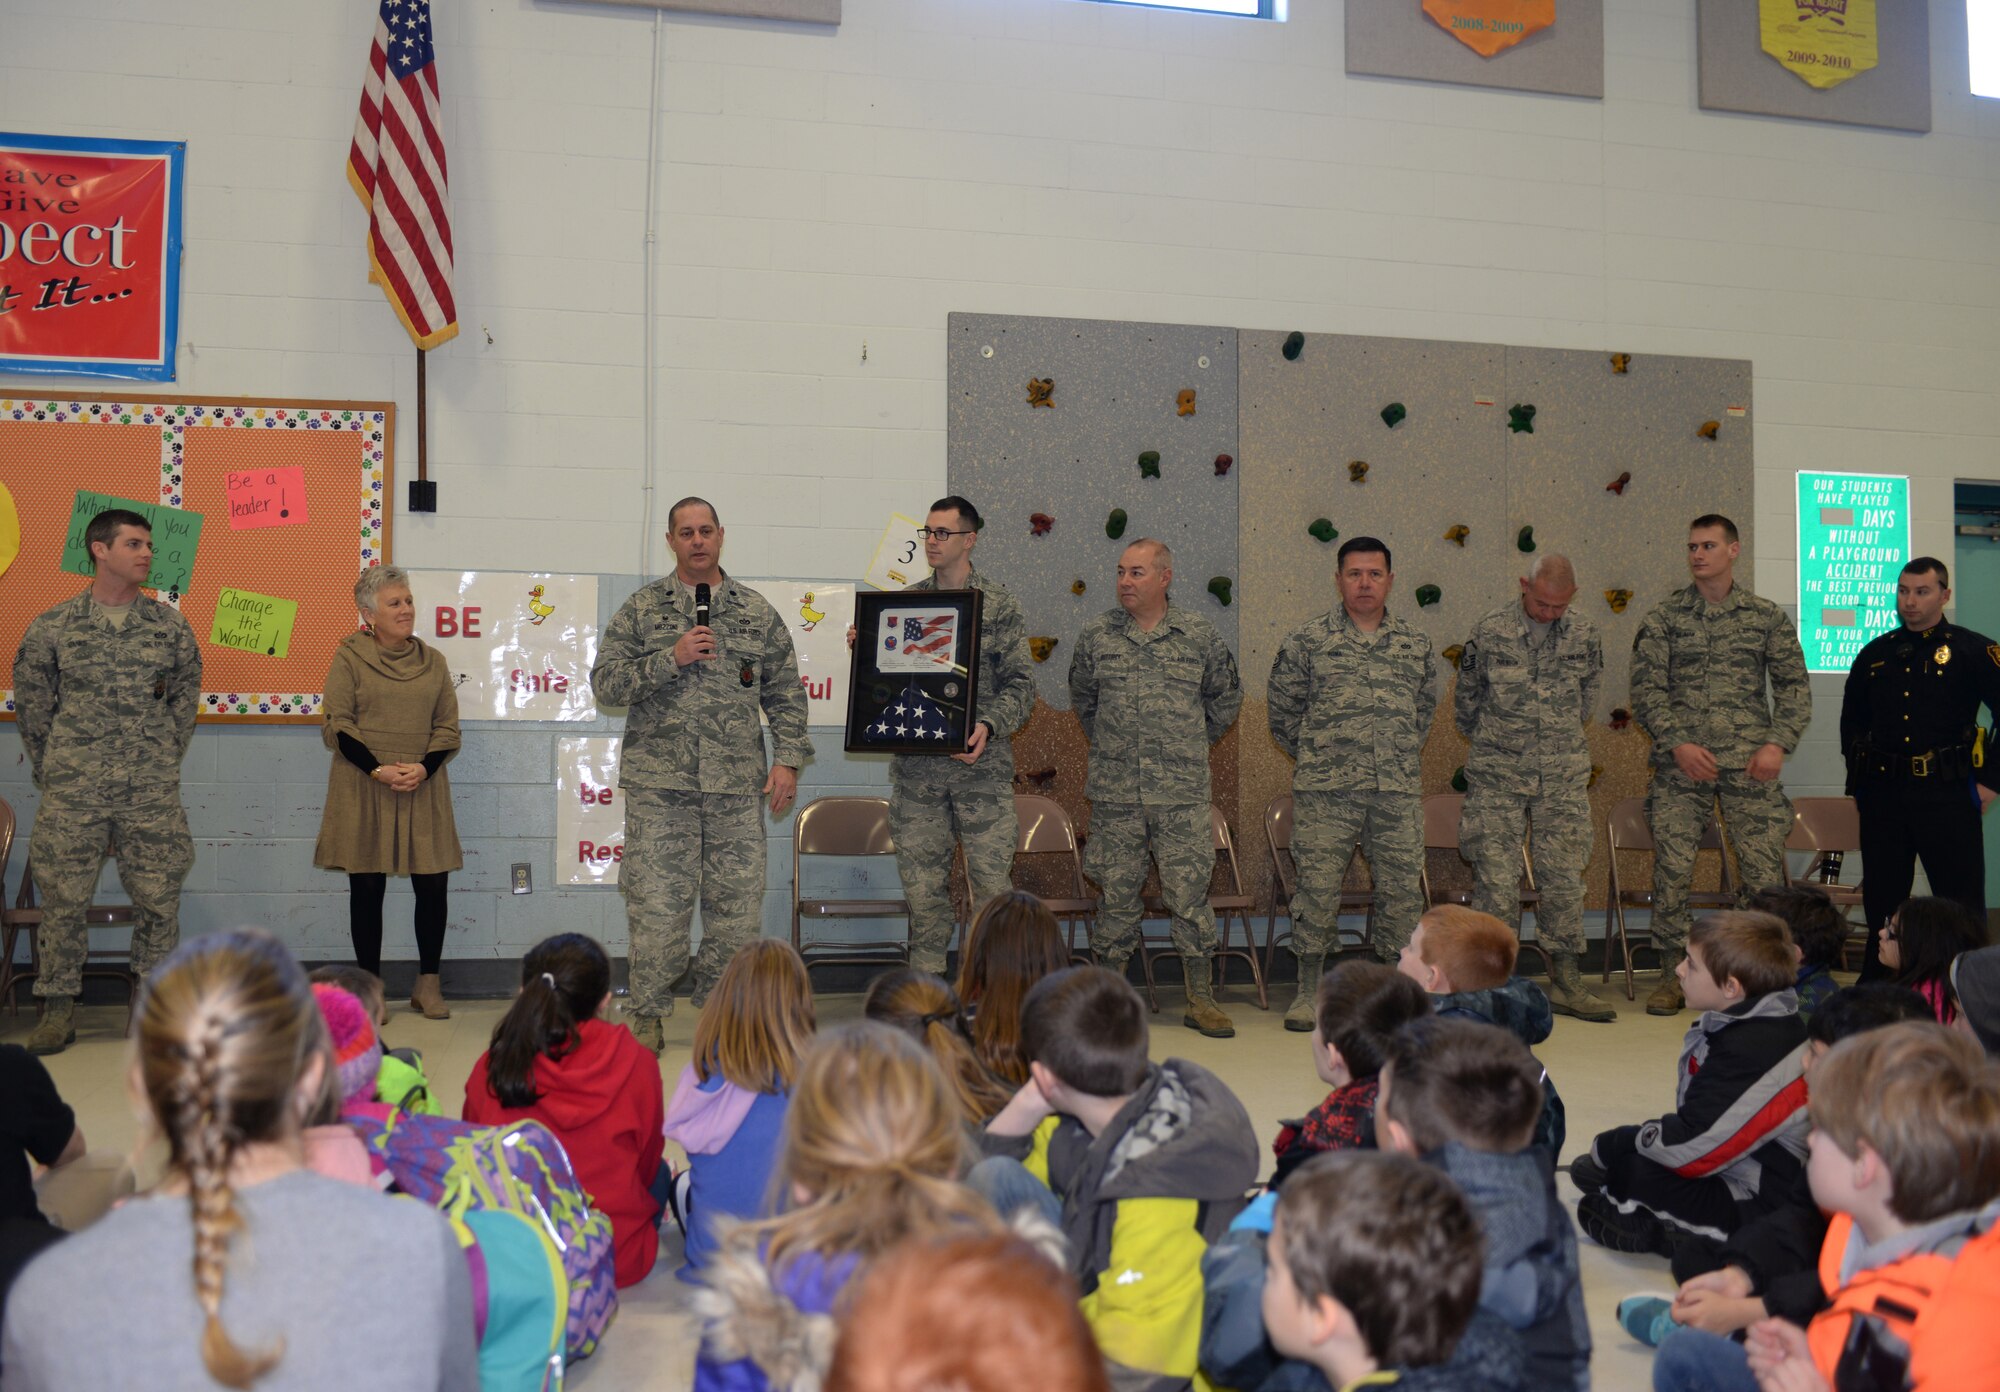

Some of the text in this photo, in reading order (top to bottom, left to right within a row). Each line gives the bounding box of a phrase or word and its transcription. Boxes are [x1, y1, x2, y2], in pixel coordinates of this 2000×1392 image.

[1451, 15, 1524, 33] 2008-2009
[1787, 49, 1851, 68] 2009-2010
[0, 169, 79, 188] ave
[227, 473, 276, 490] Be a
[1814, 479, 1892, 493] OUR STUDENTS
[231, 495, 271, 517] leader
[1817, 493, 1889, 506] HAVE PLAYED
[1862, 509, 1895, 528] DAYS
[1829, 529, 1880, 544] WITHOUT
[897, 540, 917, 564] 3
[1808, 545, 1900, 562] A PLAYGROUND
[1826, 563, 1883, 578] ACCIDENT
[1806, 580, 1823, 592] THE
[1829, 581, 1852, 593] BEST
[219, 590, 274, 619] Change
[1823, 594, 1886, 607] RECORD WAS
[238, 615, 262, 632] the
[436, 606, 481, 638] BE
[1865, 609, 1898, 628] DAYS
[219, 627, 260, 649] World
[1815, 628, 1829, 640] DO
[1837, 629, 1863, 641] YOUR
[1820, 642, 1864, 654] TO KEEP
[1820, 655, 1856, 667] SCHOO
[510, 668, 569, 693] Safe
